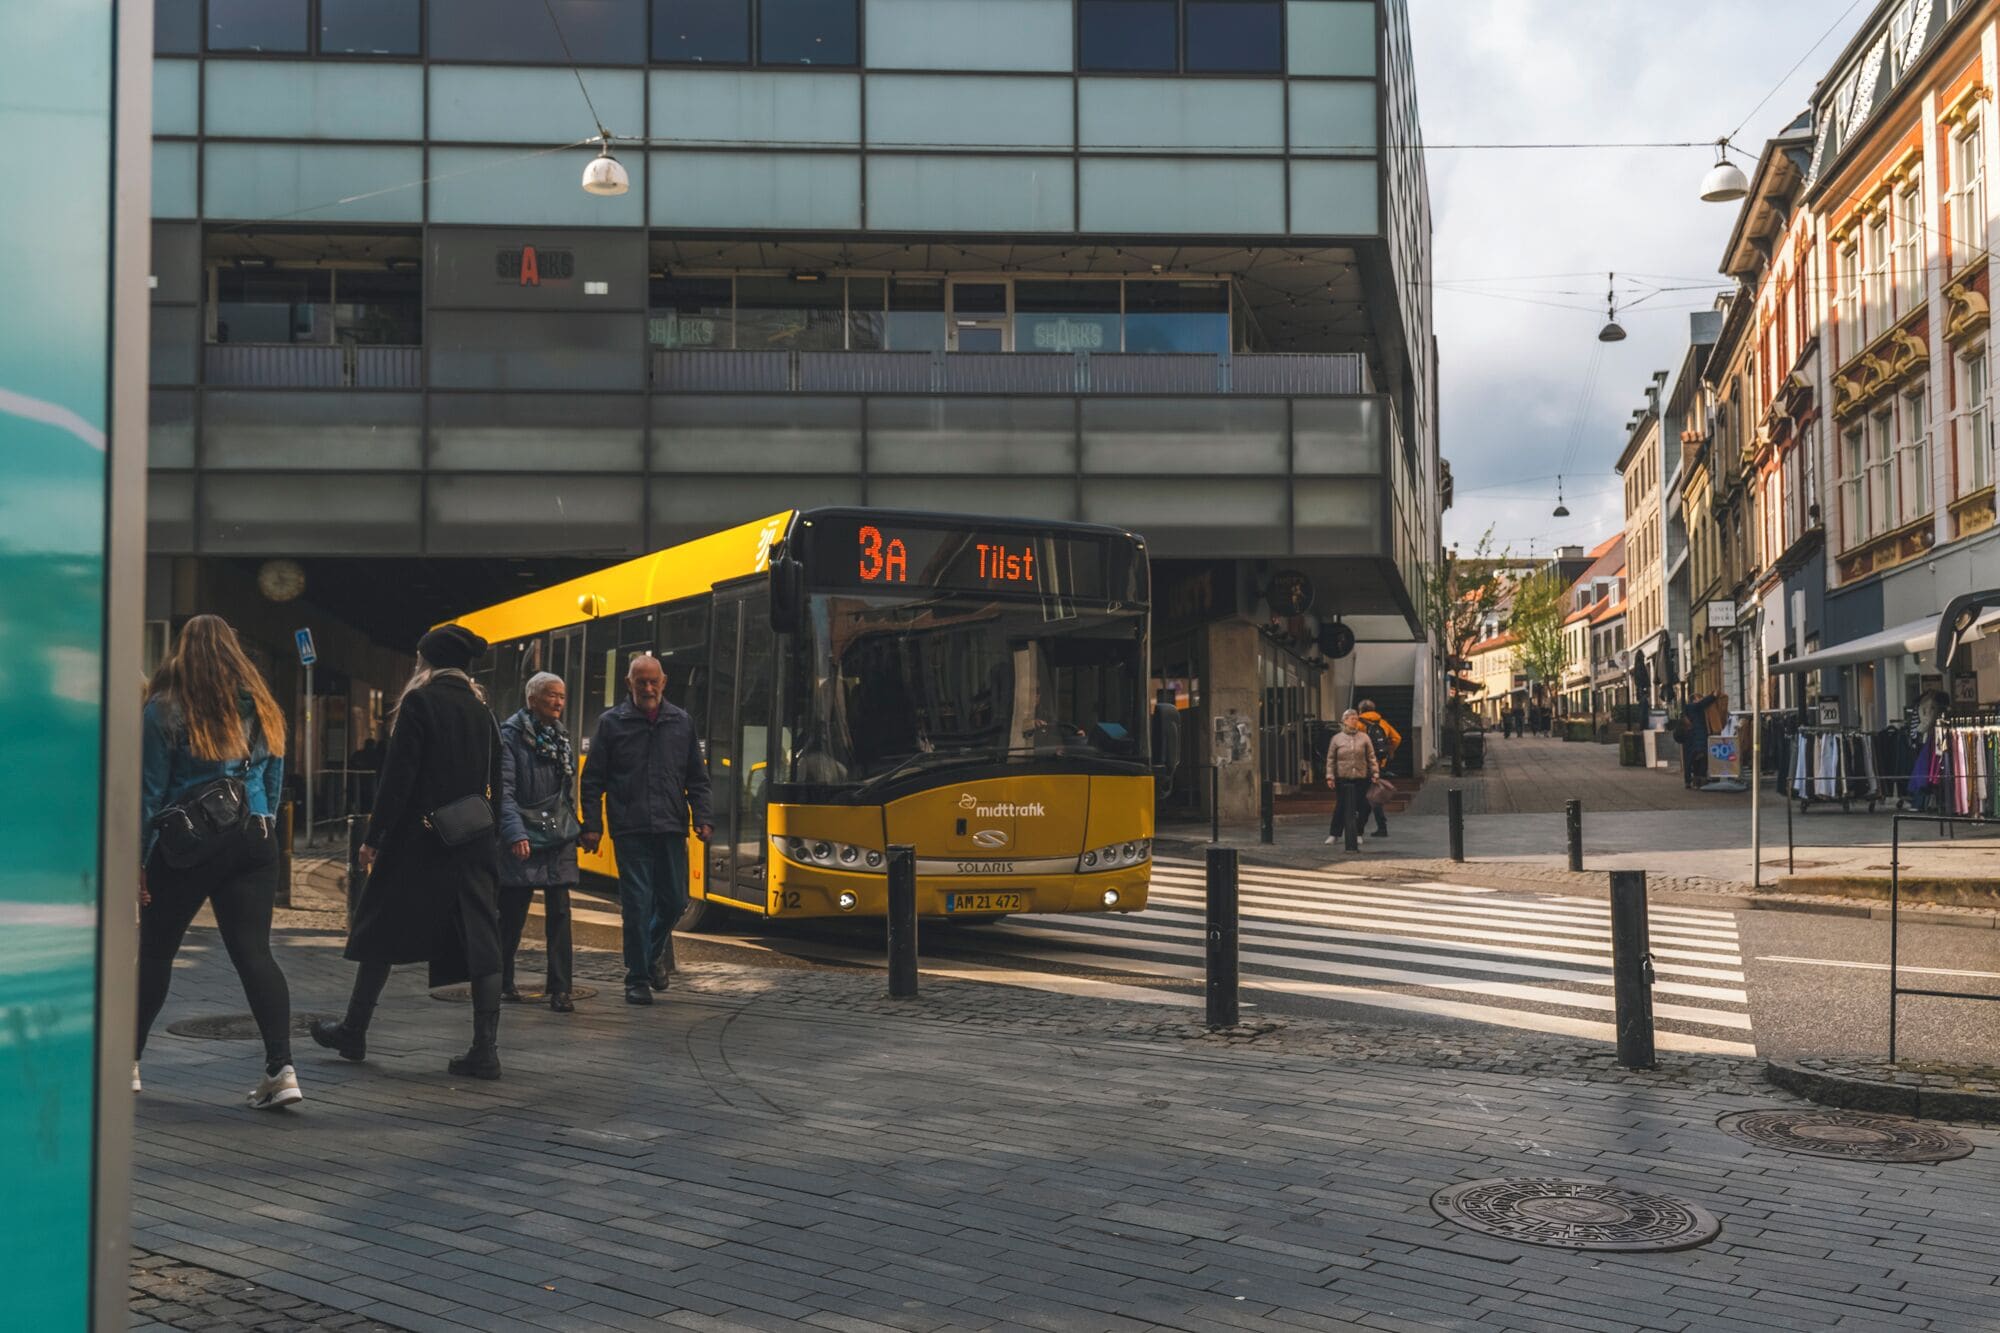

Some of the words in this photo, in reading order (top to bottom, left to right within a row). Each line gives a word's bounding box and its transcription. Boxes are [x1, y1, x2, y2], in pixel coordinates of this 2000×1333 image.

[497, 245, 574, 286] SHARKS
[1035, 318, 1102, 352] SHARKS
[859, 525, 906, 582] 3A
[976, 544, 1034, 581] Tilst
[976, 802, 1045, 817] midttrafik
[957, 862, 1014, 873] SOLARIS
[772, 890, 801, 909] 712
[955, 895, 973, 909] AM
[976, 895, 991, 909] 21
[995, 894, 1019, 908] 472
